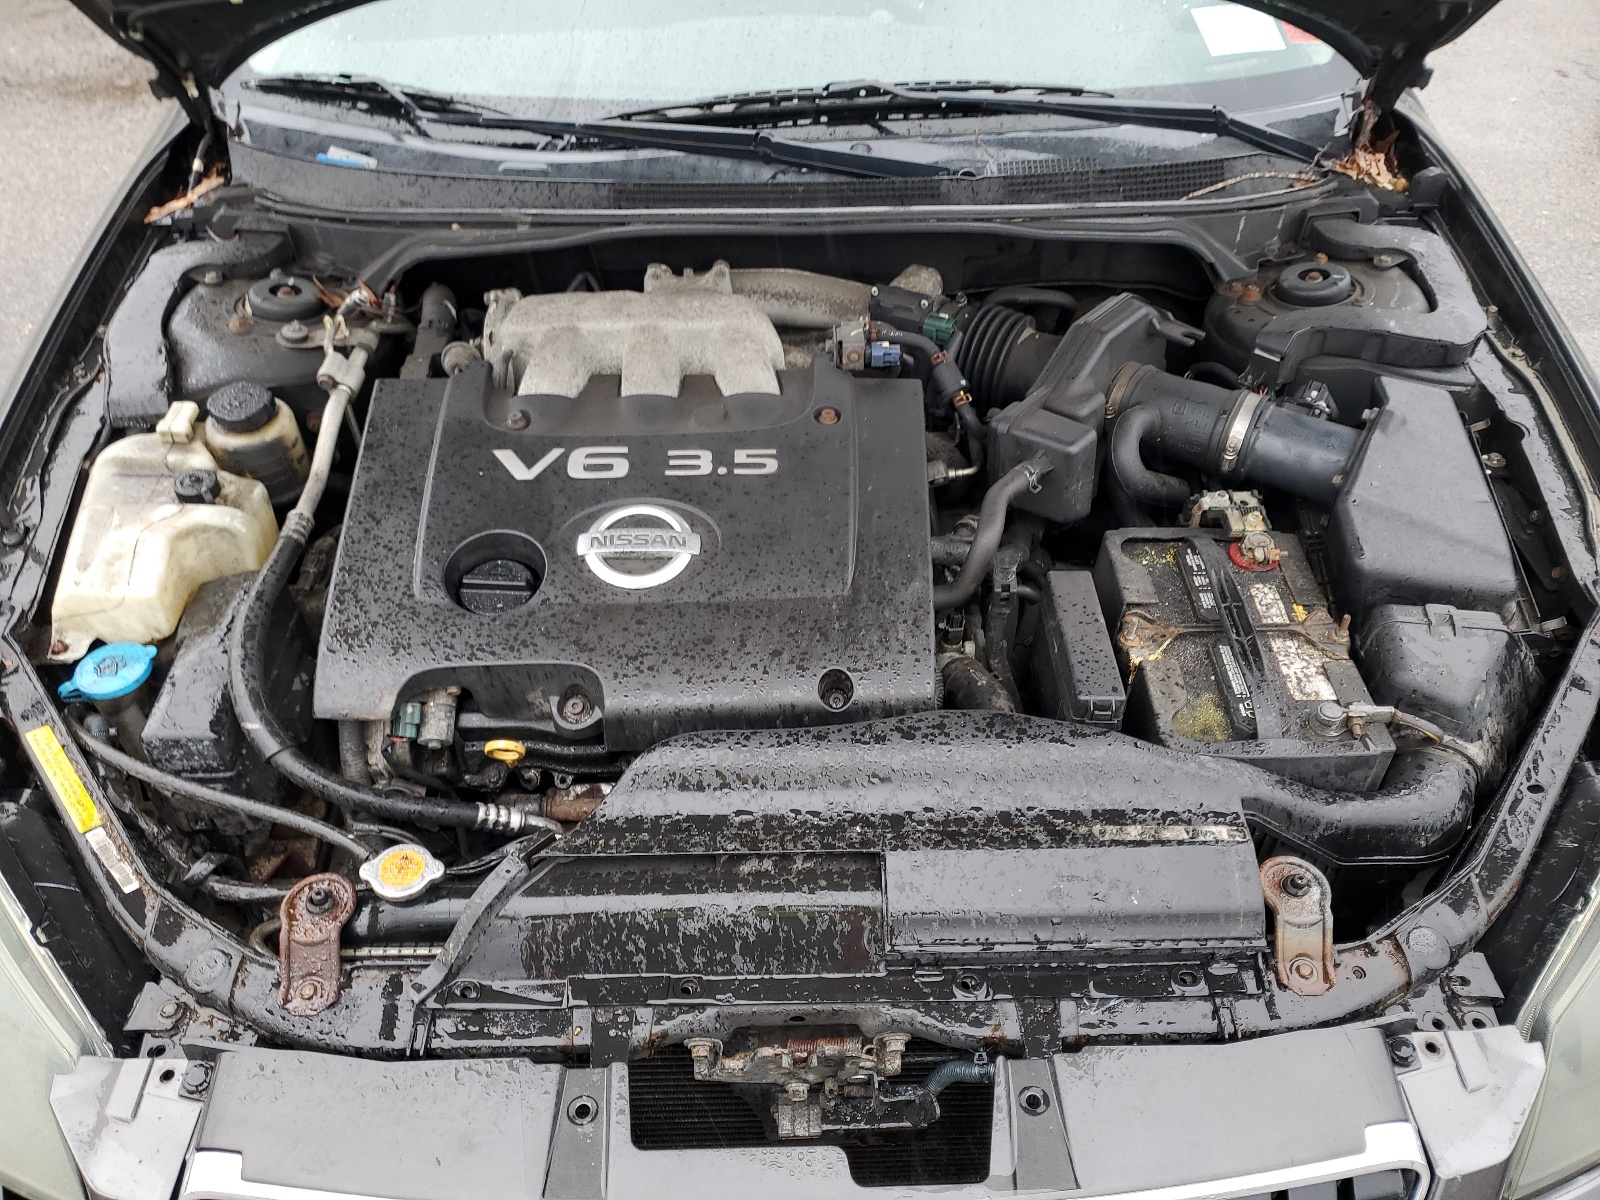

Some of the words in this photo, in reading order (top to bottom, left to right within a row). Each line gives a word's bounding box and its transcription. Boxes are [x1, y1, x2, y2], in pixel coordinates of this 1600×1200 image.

[492, 446, 630, 481] V6
[664, 449, 779, 476] 3.5
[590, 533, 688, 548] NISSAN
